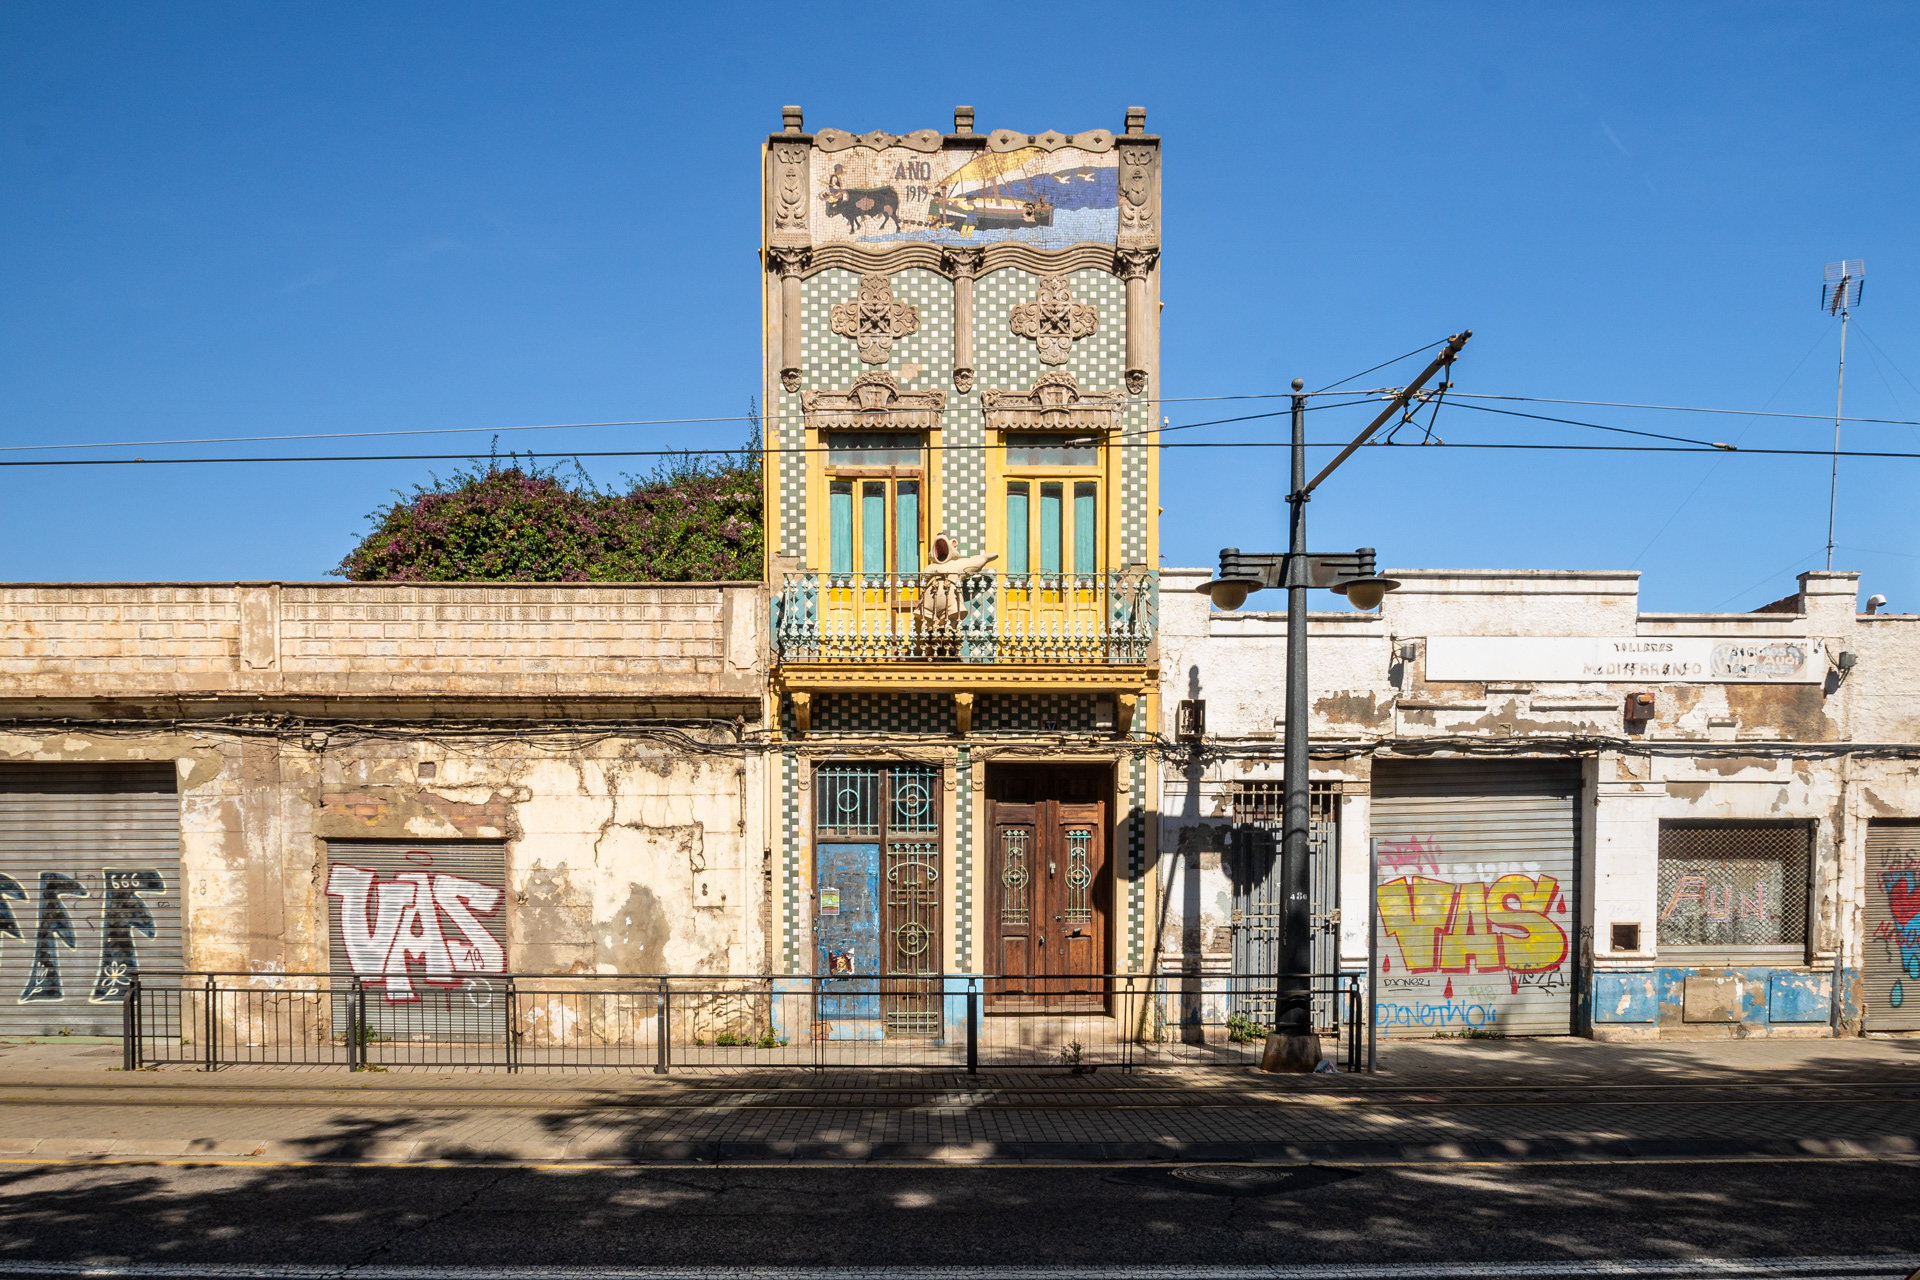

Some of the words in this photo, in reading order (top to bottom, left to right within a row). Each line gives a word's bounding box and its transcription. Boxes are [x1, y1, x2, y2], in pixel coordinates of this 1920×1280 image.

[895, 155, 931, 181] AÑO
[905, 186, 929, 203] 1919
[111, 873, 140, 889] 666
[325, 862, 507, 1005] VAS
